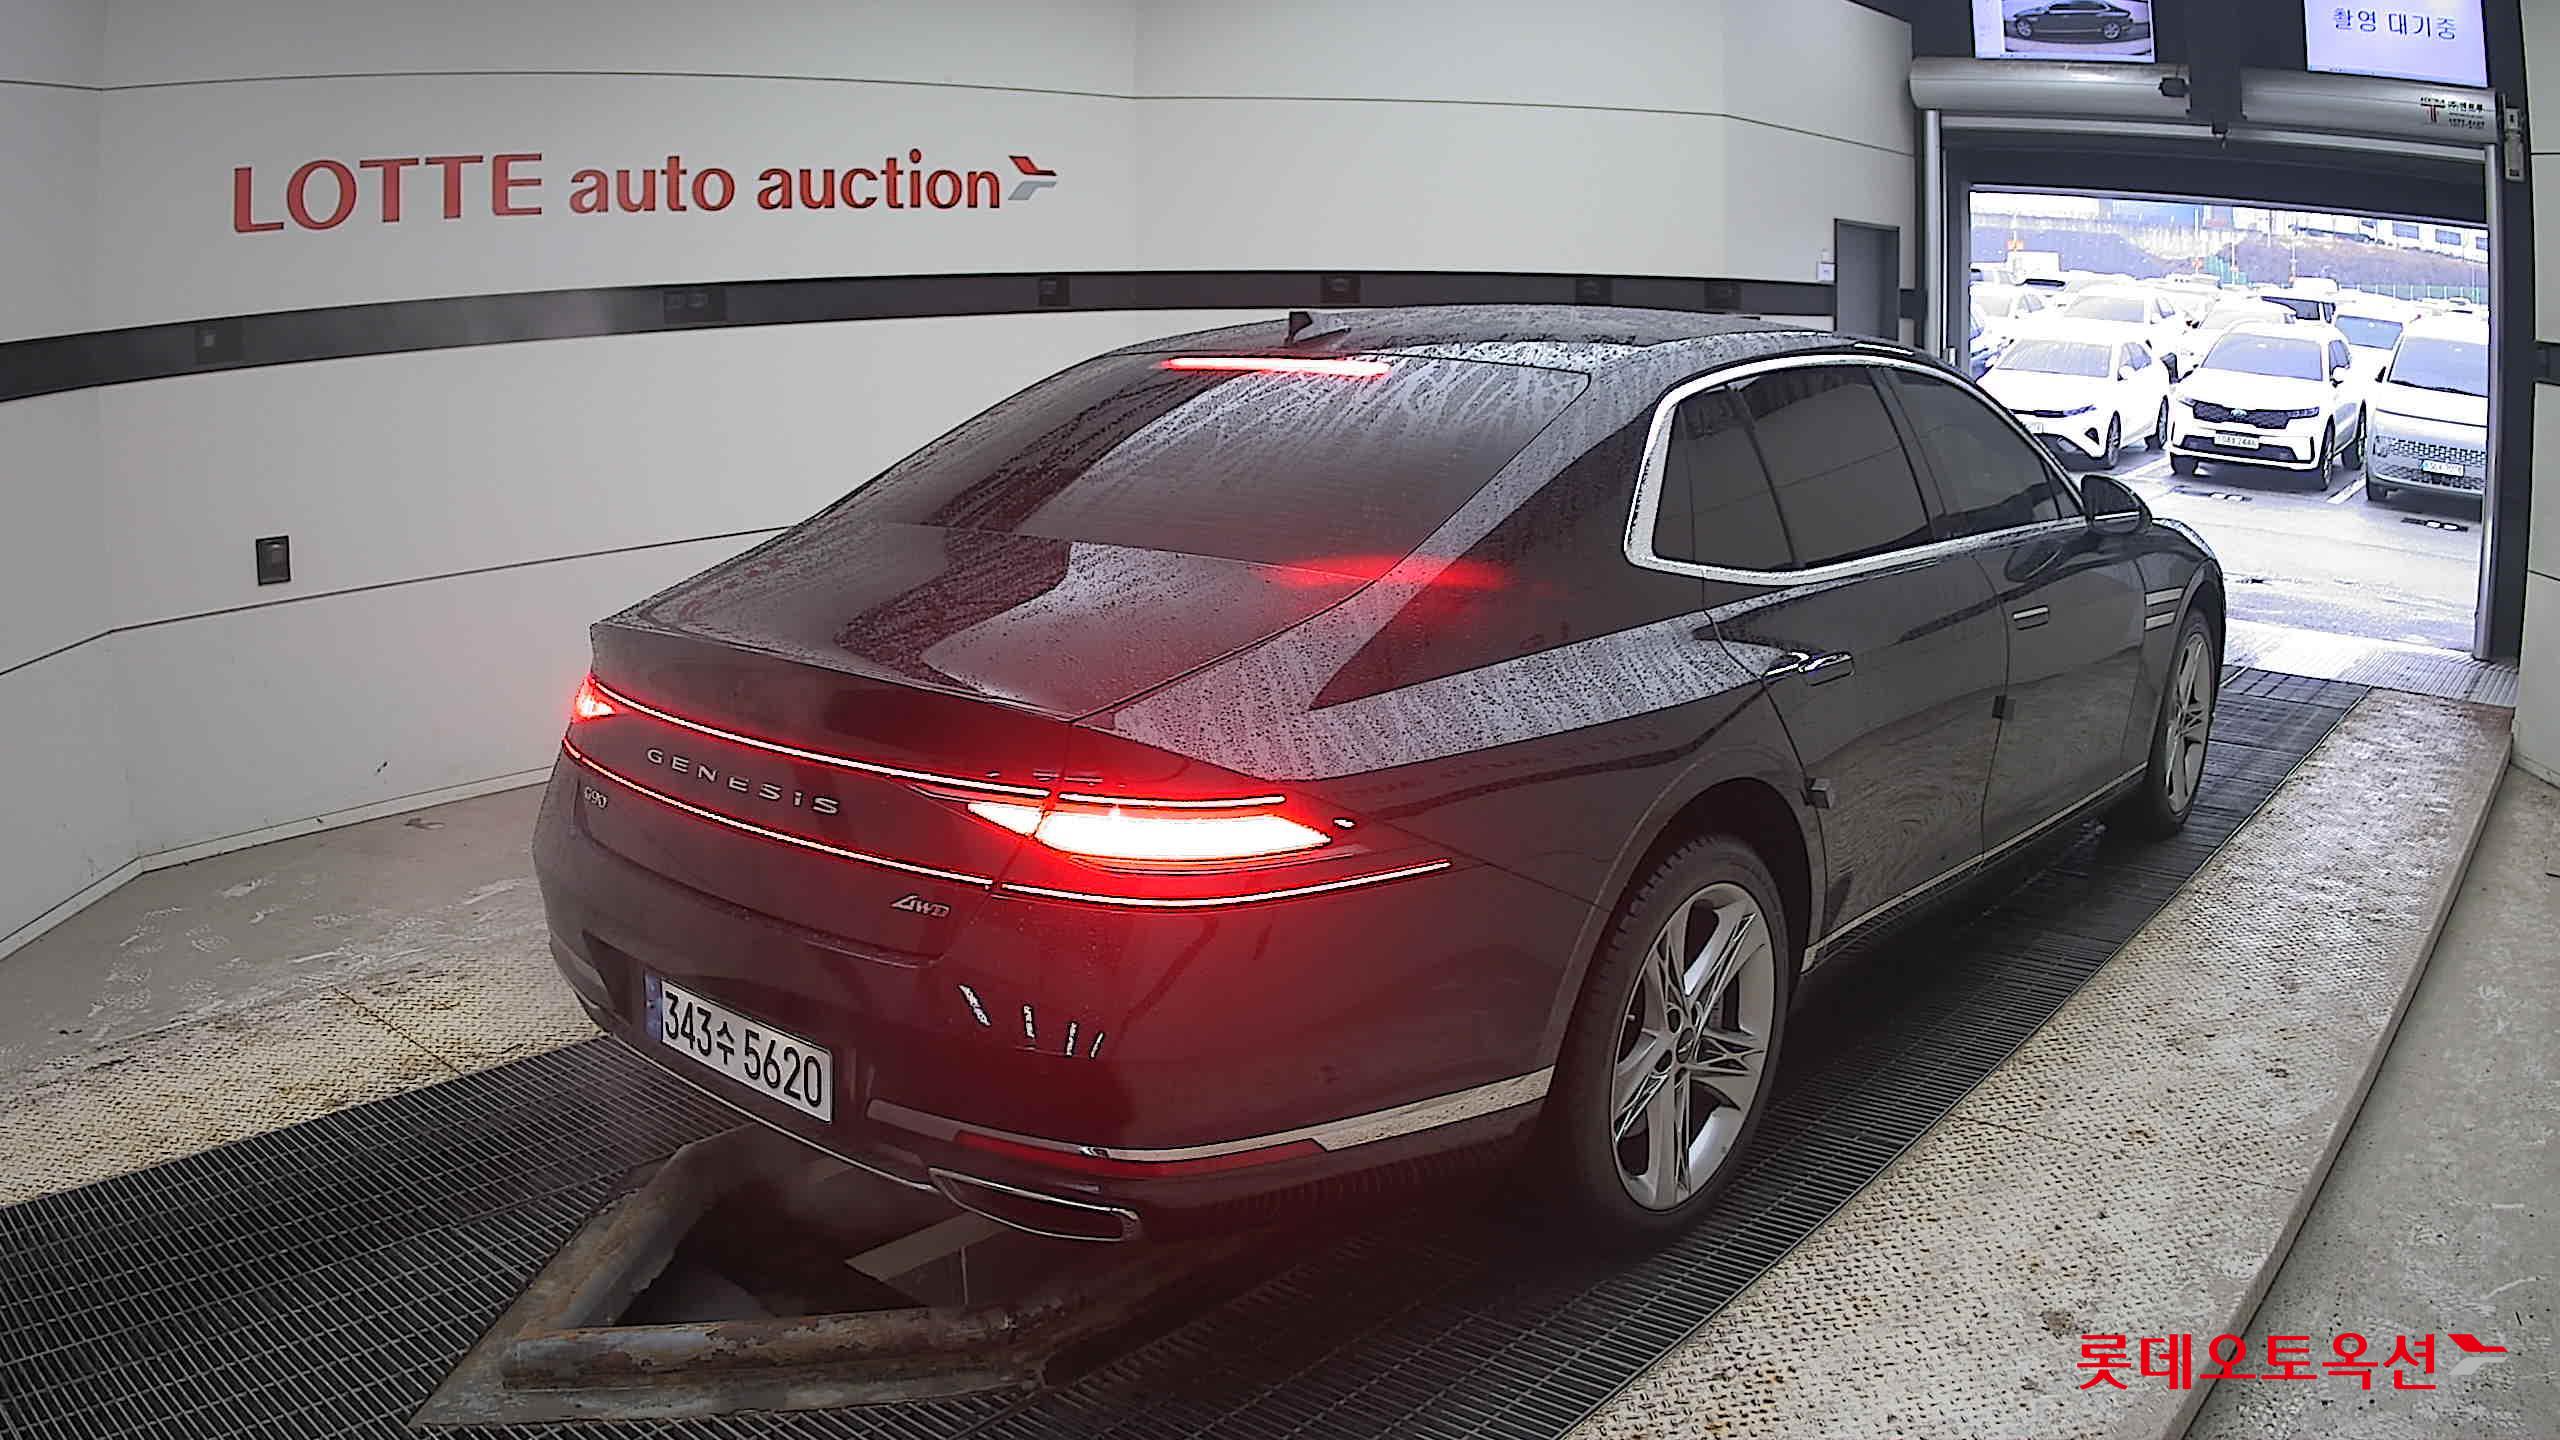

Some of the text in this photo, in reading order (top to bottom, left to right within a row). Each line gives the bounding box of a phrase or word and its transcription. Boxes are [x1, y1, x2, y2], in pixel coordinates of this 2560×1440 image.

[2334, 8, 2457, 40] 촬영 대기중
[234, 148, 1001, 232] LOTTE auto auction
[646, 748, 840, 815] GENESIS
[664, 990, 823, 1108] 343수 5620
